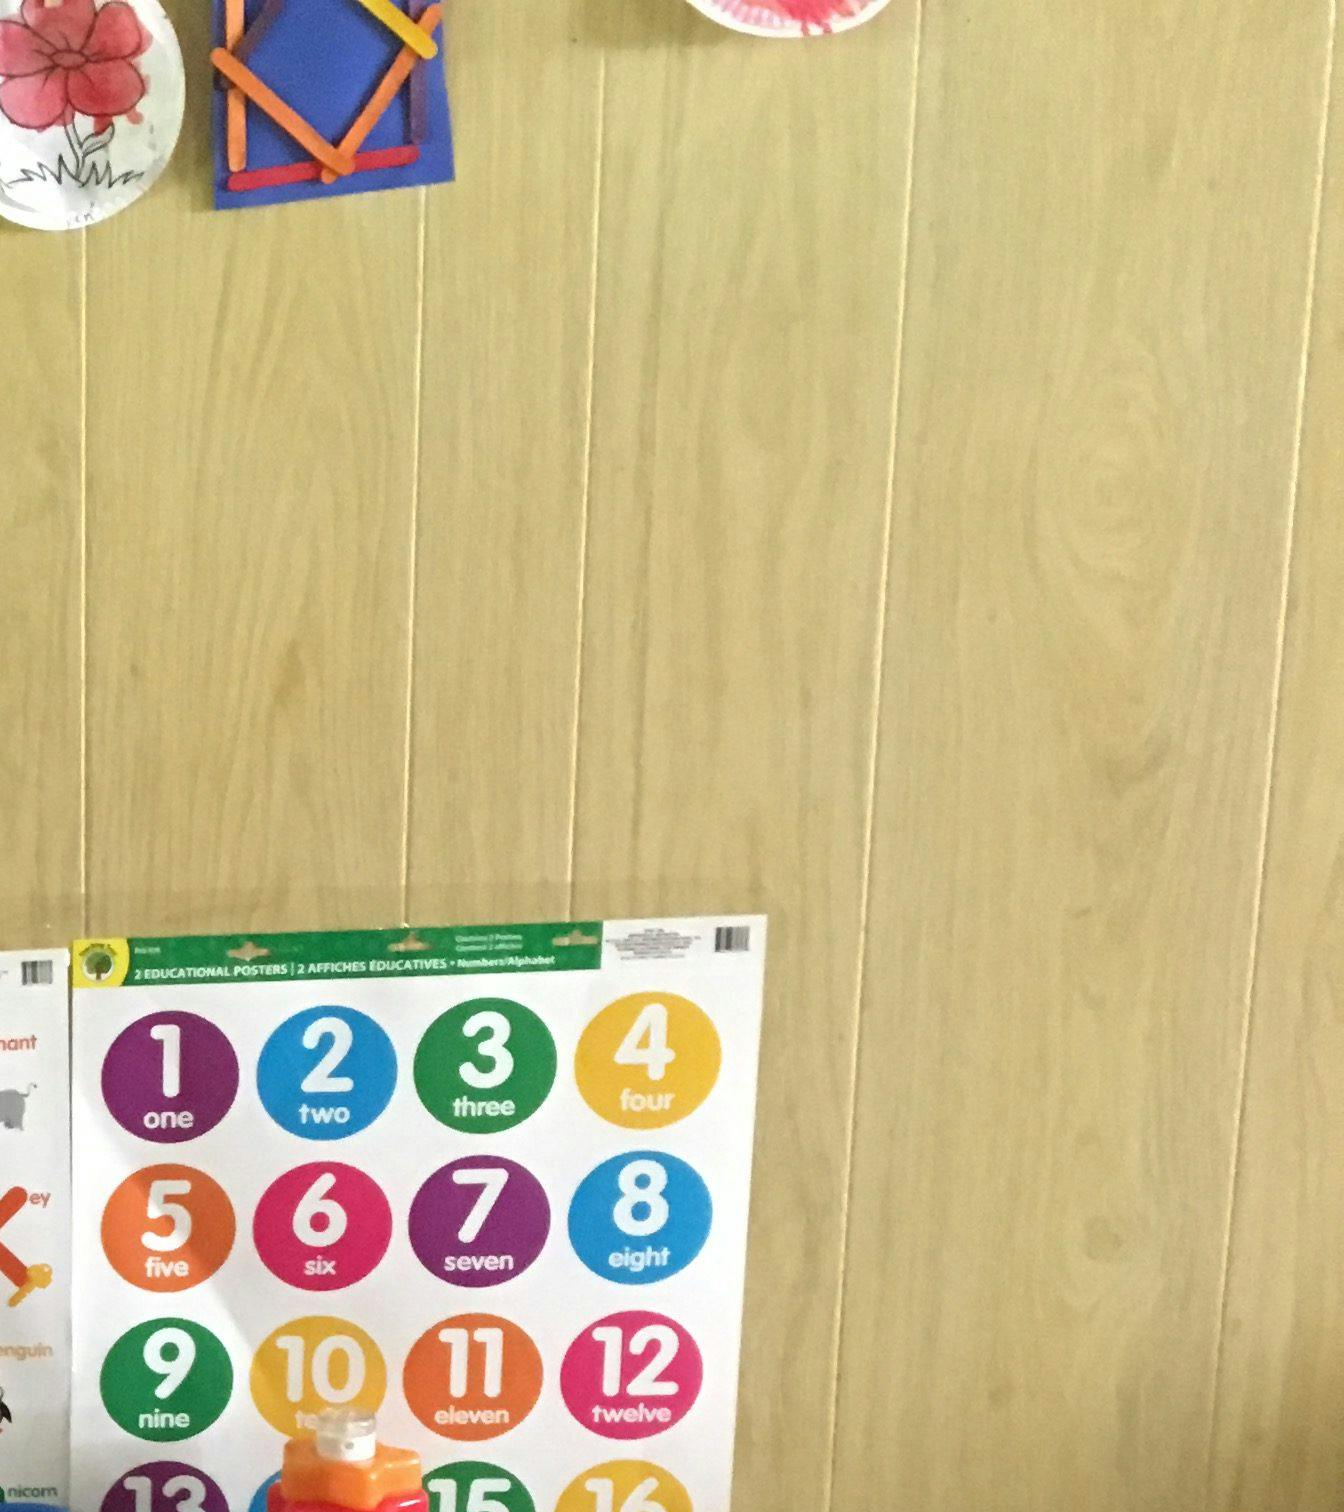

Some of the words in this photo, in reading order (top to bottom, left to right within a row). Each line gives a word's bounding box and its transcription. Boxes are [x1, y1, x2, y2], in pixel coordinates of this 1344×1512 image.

[144, 966, 230, 980] EDUCATIONAL
[234, 964, 288, 976] POSTERS
[308, 961, 366, 974] AFFICHES
[150, 1024, 180, 1097] 1
[301, 1017, 353, 1092] 2
[459, 1011, 513, 1088] 3
[614, 1003, 675, 1080] 4
[144, 1111, 193, 1129] one
[299, 1104, 350, 1124] two
[453, 1096, 515, 1117] three
[620, 1088, 675, 1112] four
[141, 1180, 191, 1252] 5
[293, 1173, 347, 1247] 6
[452, 1168, 509, 1243] 7
[613, 1160, 669, 1236] 8
[145, 1256, 189, 1277] five
[304, 1255, 336, 1275] six
[444, 1255, 514, 1271] seven
[609, 1246, 670, 1272] eight
[143, 1328, 196, 1399] 9
[276, 1335, 365, 1405] 10
[439, 1328, 503, 1398] 11
[592, 1325, 679, 1396] 12
[139, 1408, 189, 1428] nine
[434, 1405, 509, 1424] eleven
[592, 1403, 671, 1422] twelve
